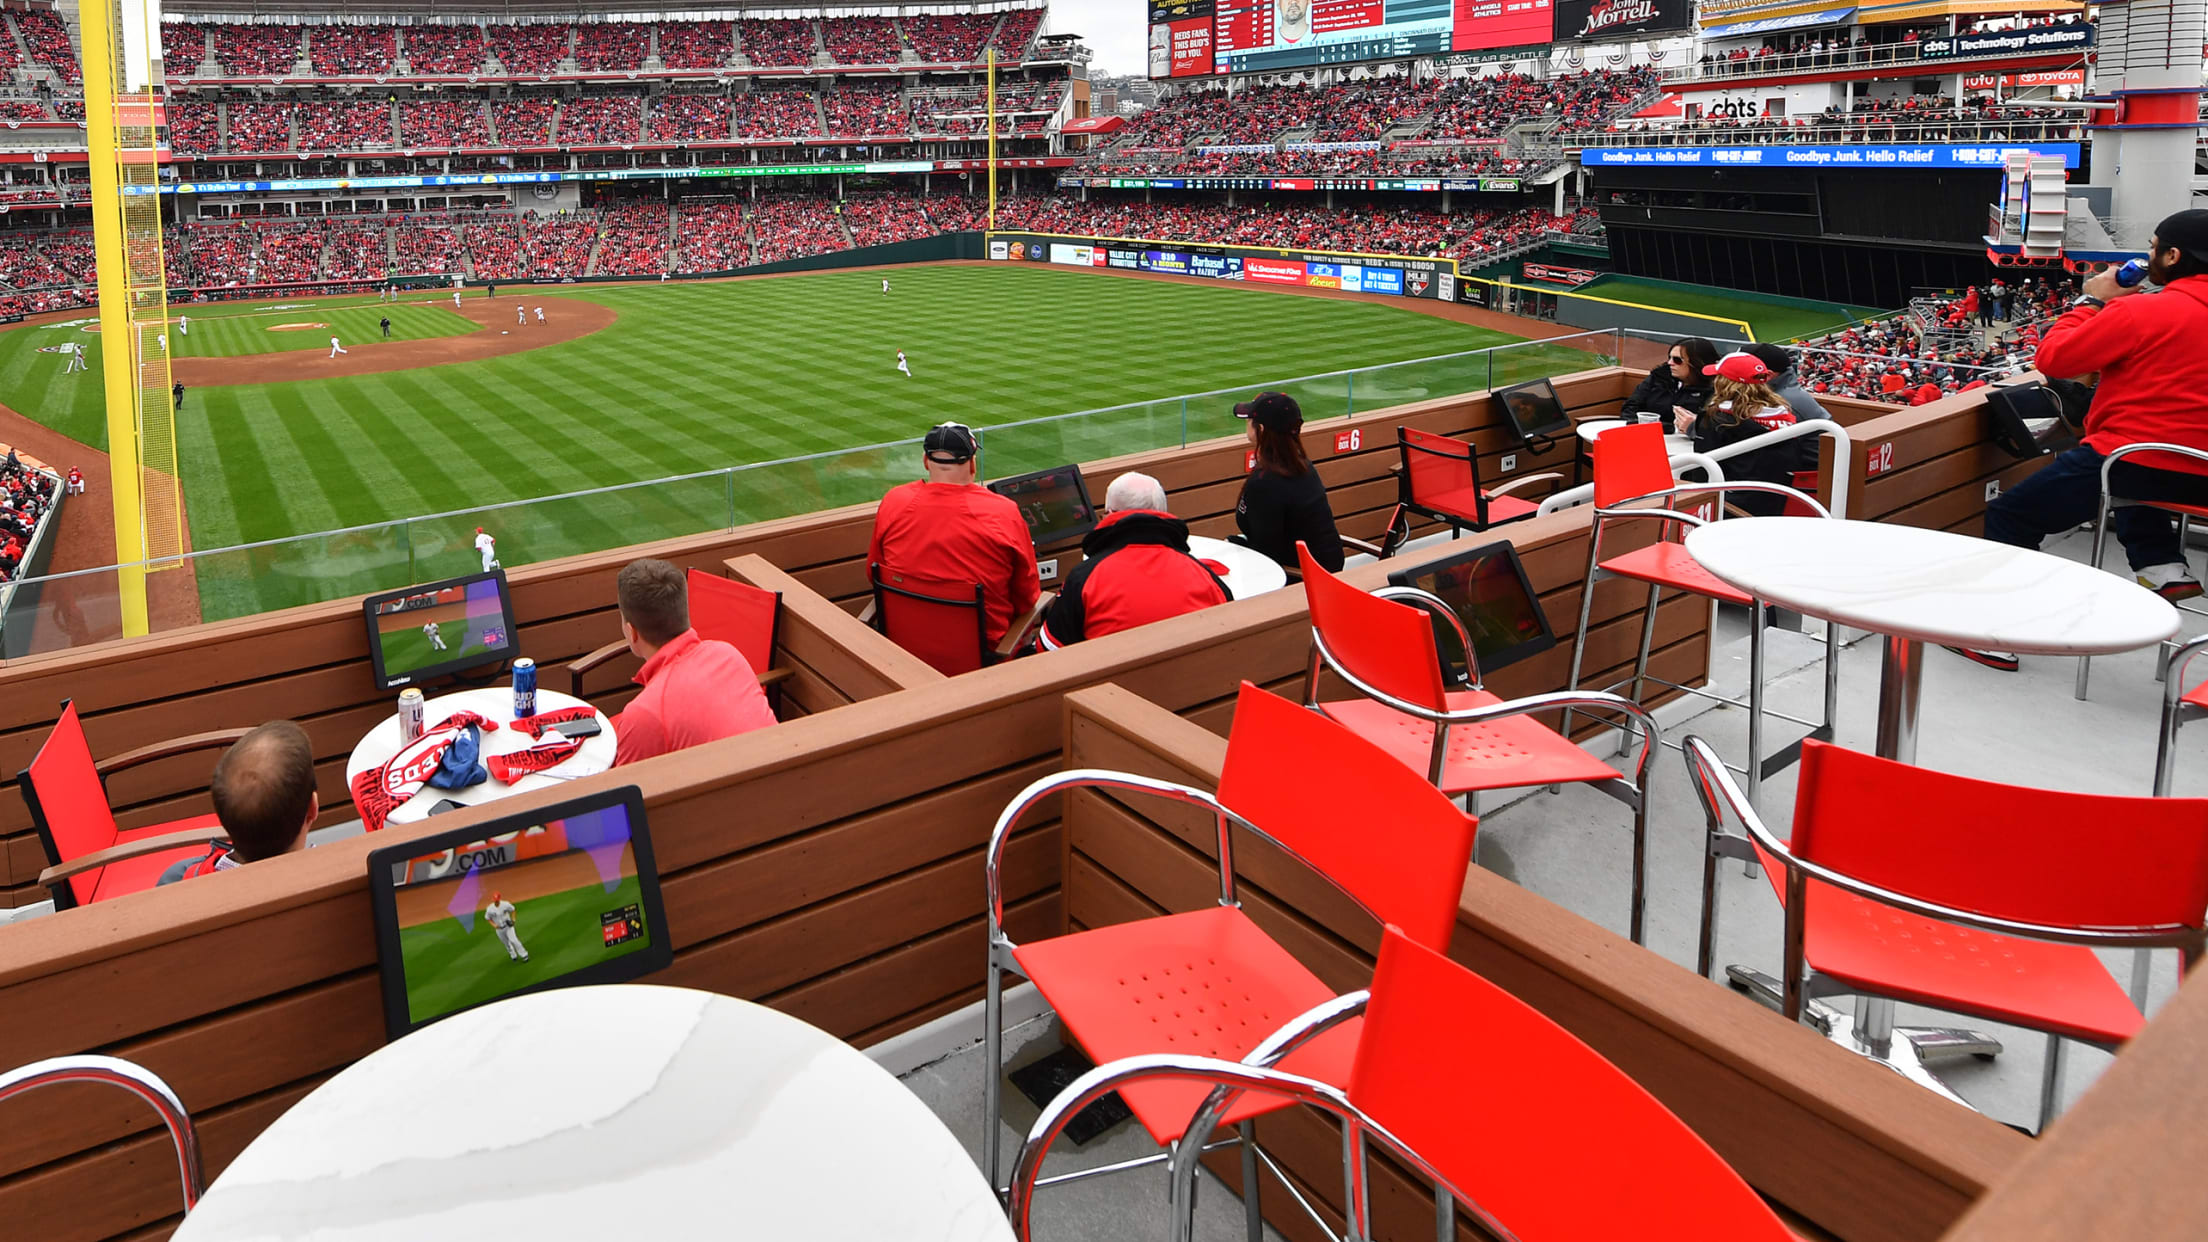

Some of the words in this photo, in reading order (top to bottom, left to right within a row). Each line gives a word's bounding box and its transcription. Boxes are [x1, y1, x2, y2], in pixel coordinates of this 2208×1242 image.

[1579, 1, 1660, 35] Morrell
[1174, 31, 1190, 40] REDS
[1192, 28, 1210, 38] FANS,
[1174, 40, 1188, 50] THIS
[1190, 38, 1210, 48] BUD'S
[1924, 41, 1950, 52] cbts
[1960, 36, 2026, 50] Technology
[2028, 30, 2086, 44] Solutions
[1174, 50, 1187, 59] FOR
[1188, 48, 1202, 58] YOU.
[1364, 46, 1369, 55] 1
[1374, 44, 1378, 54] 1
[1382, 44, 1390, 53] 2
[1435, 56, 1480, 66] ULTIMATE
[1500, 50, 1547, 60] SHUTTLE
[1965, 74, 2008, 86] TOYOA
[2038, 72, 2080, 82] TOYOTA
[1712, 98, 1756, 118] cbts
[1602, 152, 1633, 163] Goodbye
[1634, 152, 1654, 162] Junk.
[1656, 151, 1675, 161] Hello
[1677, 150, 1701, 161] Relief
[1786, 150, 1831, 164] Goodbye
[1833, 150, 1863, 162] Junk.
[1866, 150, 1896, 162] Hello
[1898, 149, 1934, 162] Relief
[536, 183, 553, 192] FOX
[1489, 181, 1516, 189] Evans
[1192, 255, 1224, 269] Barbasol
[1362, 258, 1384, 266] "REDS"
[1408, 271, 1427, 280] MLB
[1338, 440, 1349, 450] BOX
[1350, 428, 1360, 451] 6
[1869, 460, 1879, 472] BOX
[1880, 442, 1892, 472] 12
[456, 846, 506, 874] .COM
